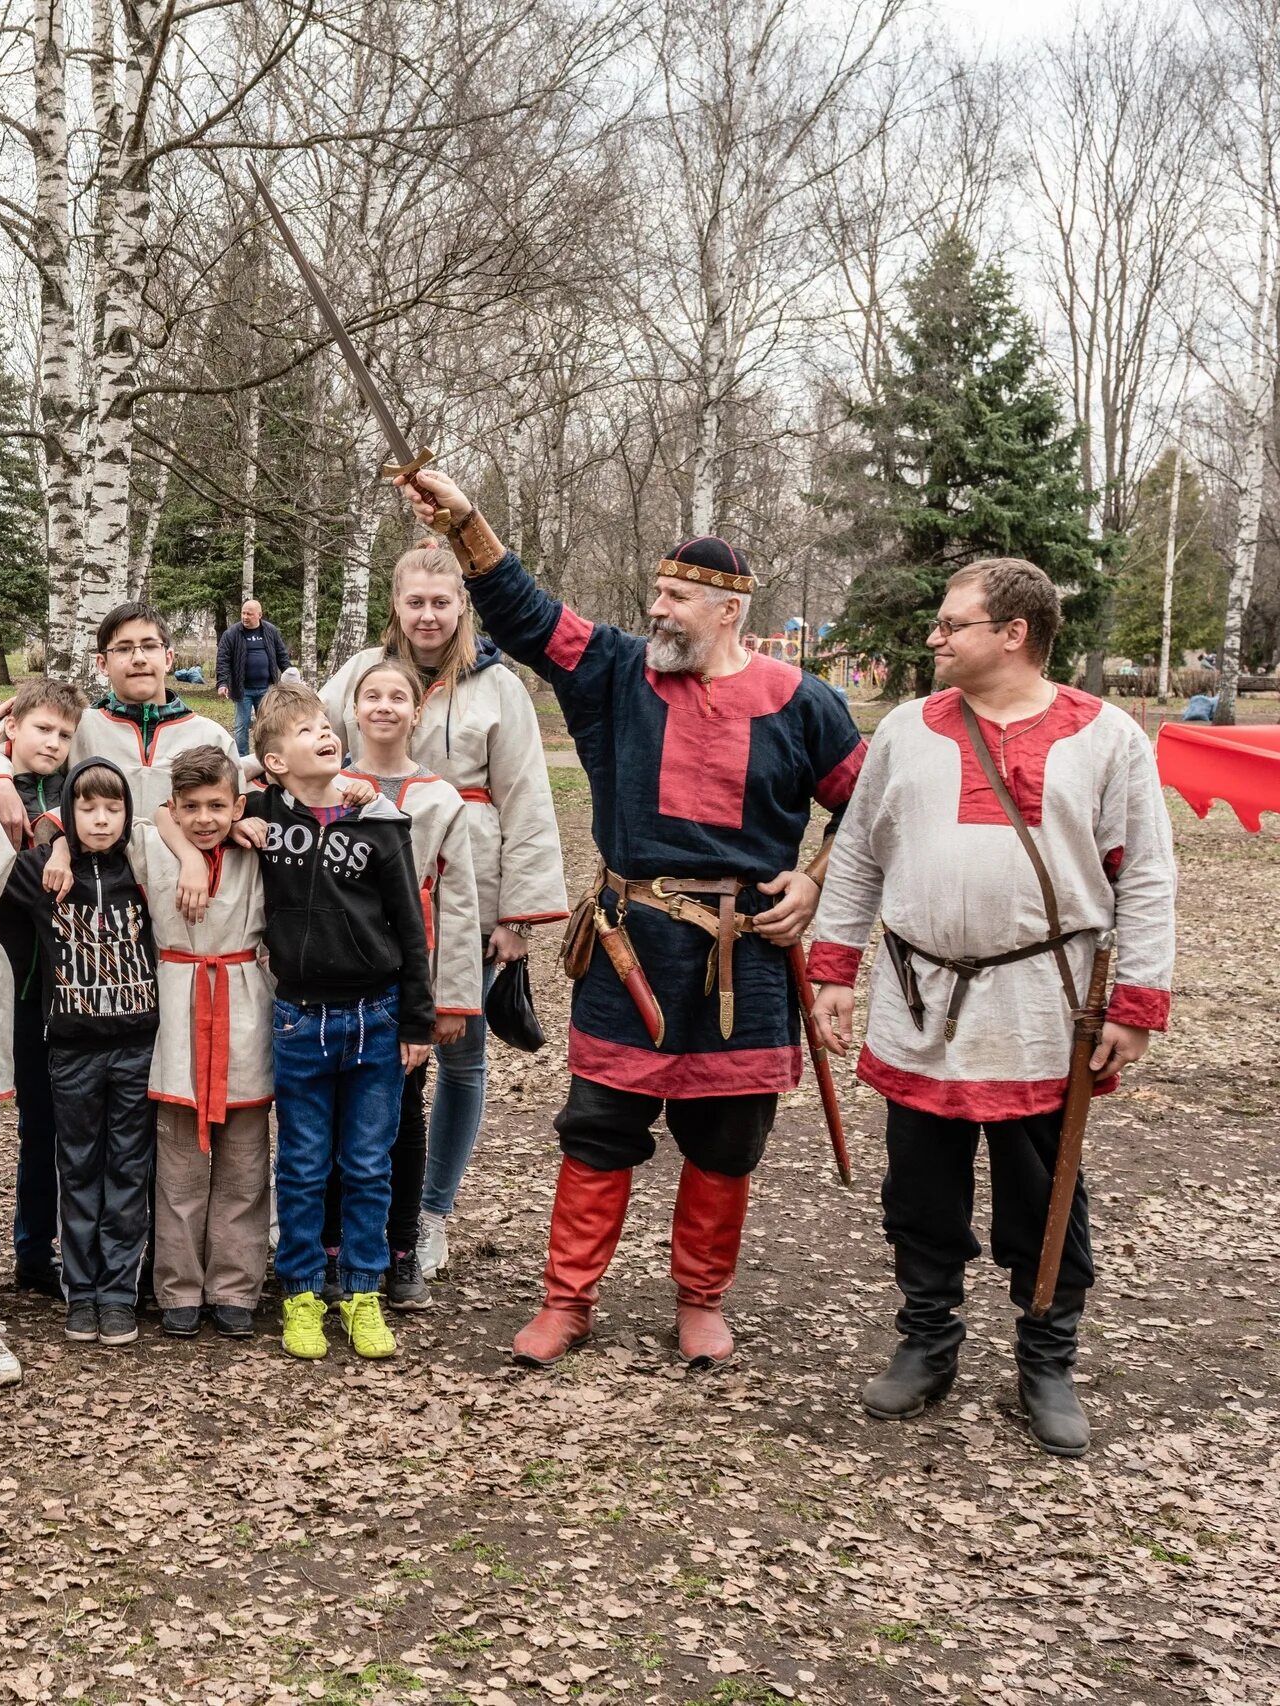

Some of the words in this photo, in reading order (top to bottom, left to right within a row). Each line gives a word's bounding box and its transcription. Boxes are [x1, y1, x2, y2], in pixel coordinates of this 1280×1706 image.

[261, 822, 373, 871] BOSS
[264, 854, 304, 866] UGO
[55, 986, 102, 1014] NEW
